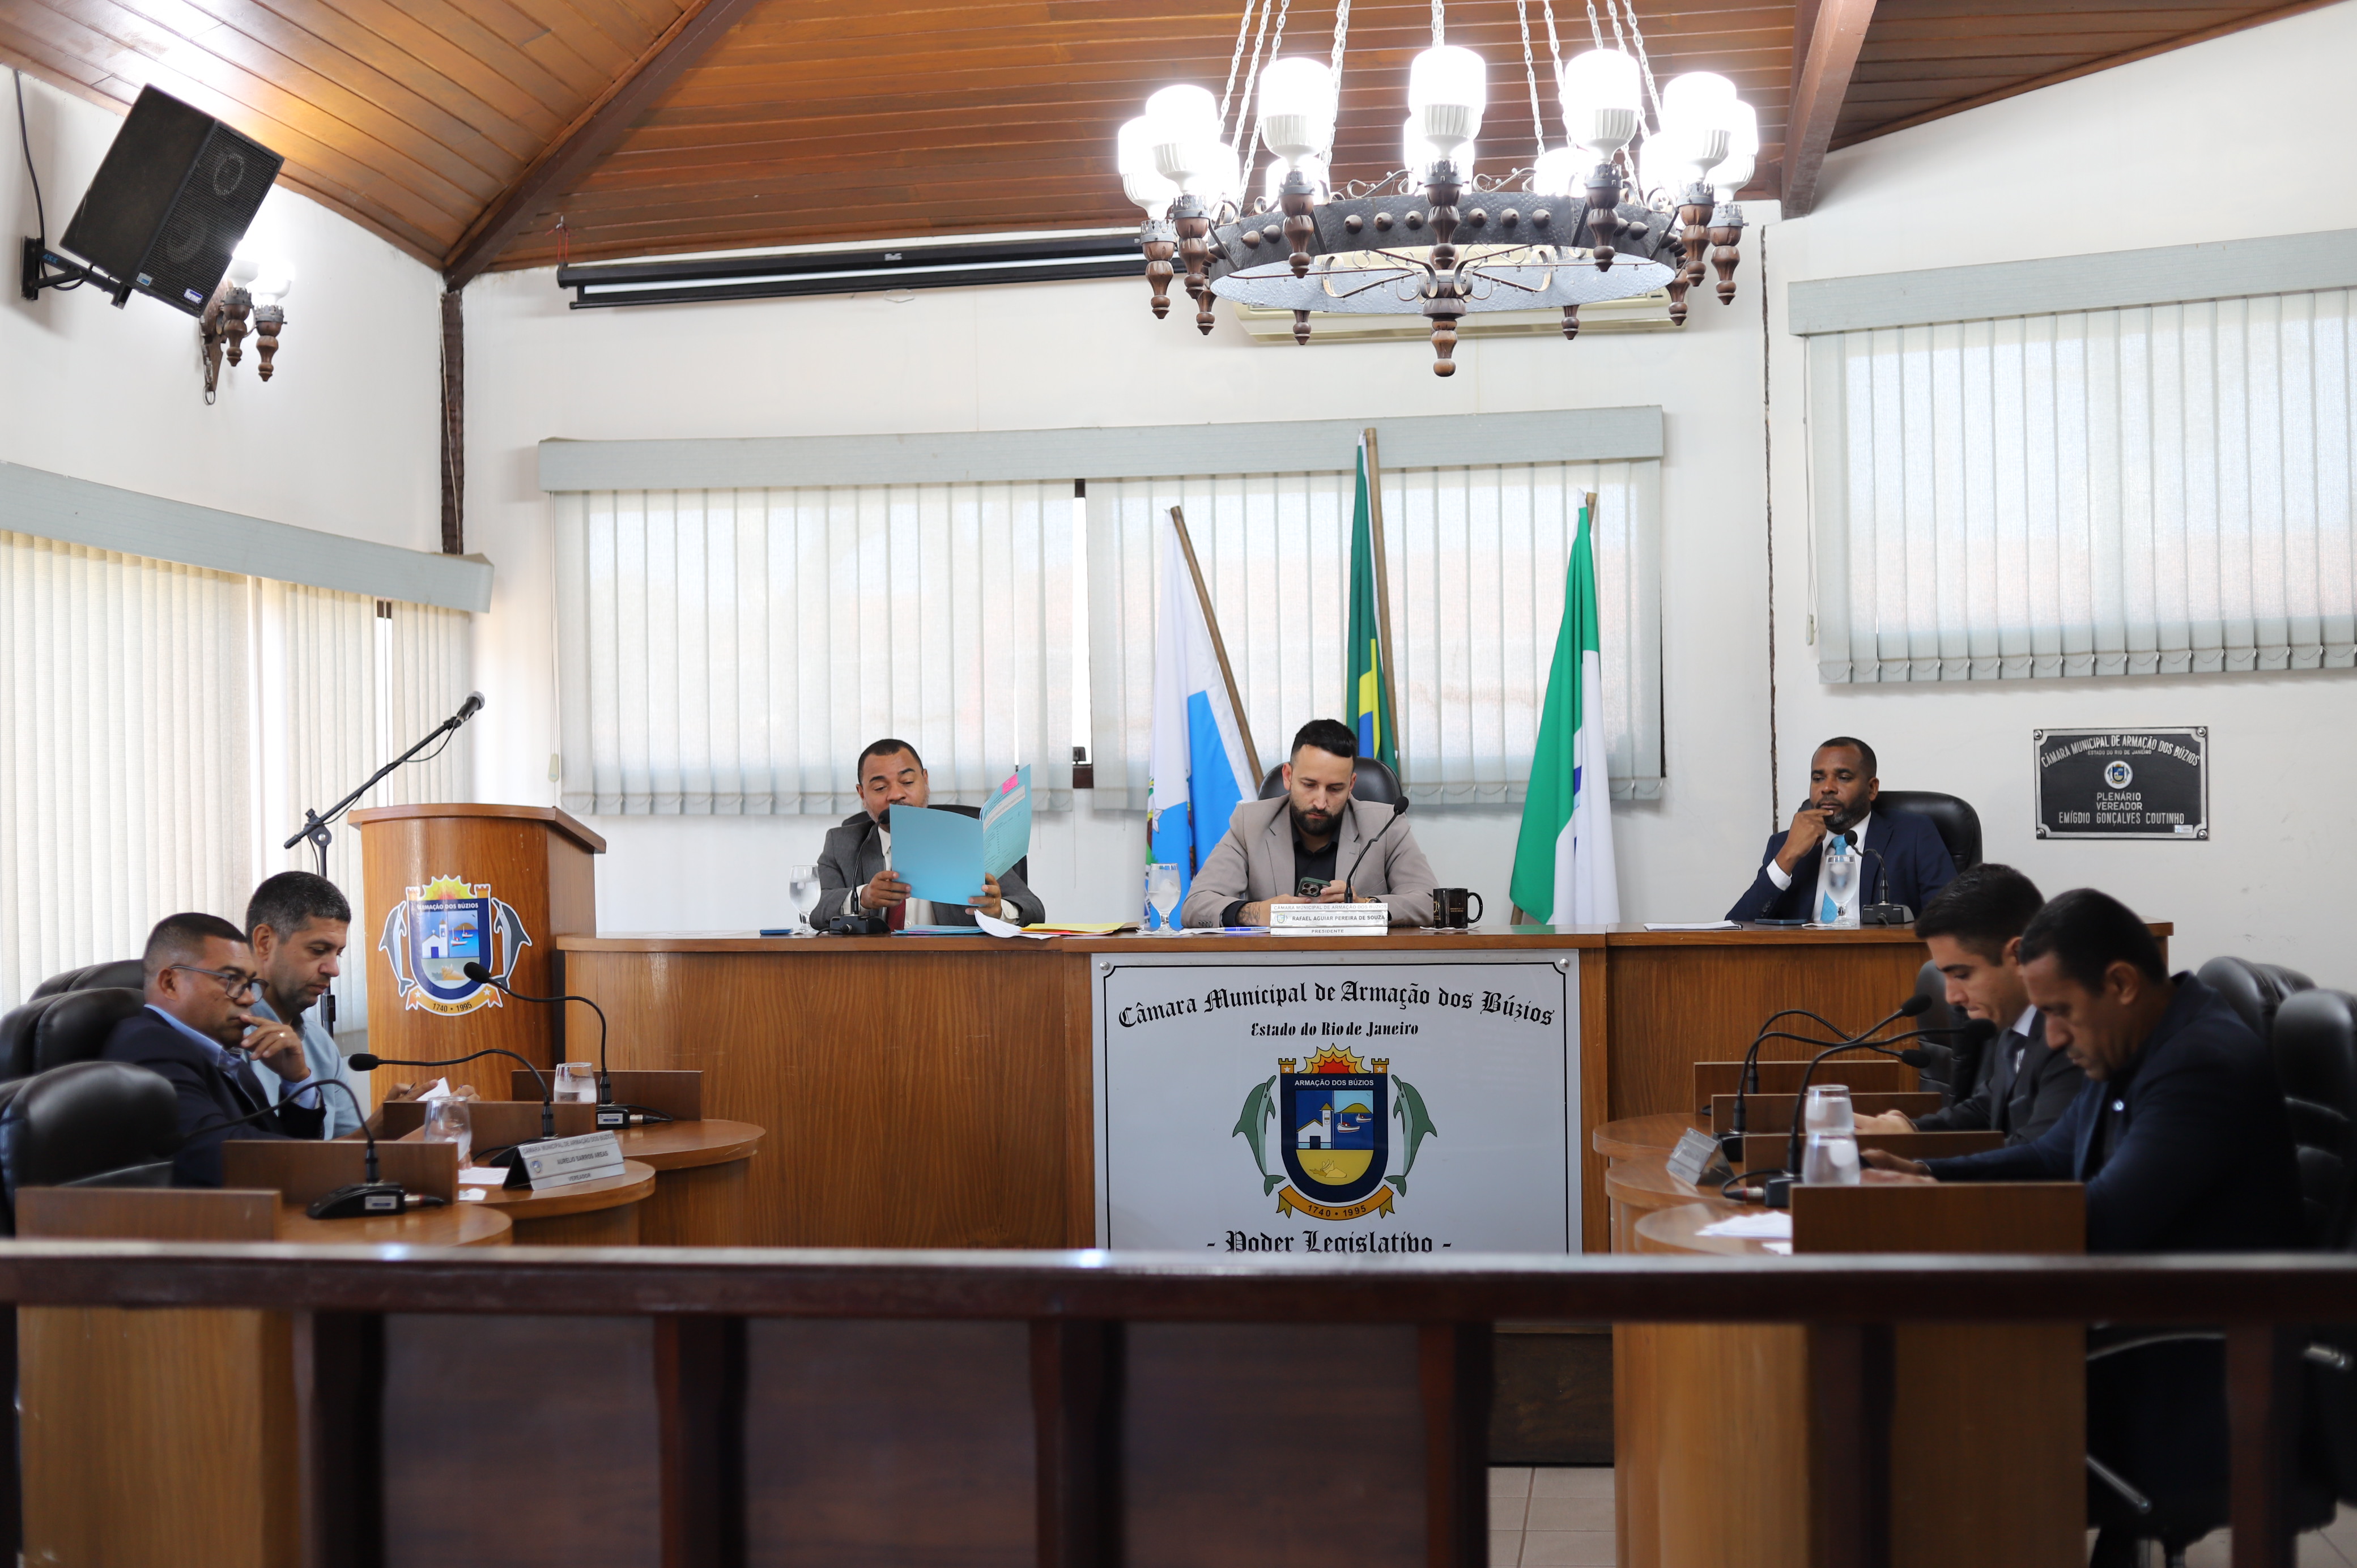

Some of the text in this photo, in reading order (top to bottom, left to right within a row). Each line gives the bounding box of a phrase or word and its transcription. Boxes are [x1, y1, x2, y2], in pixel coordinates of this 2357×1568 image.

[2071, 736, 2109, 755] MUNICIPAL
[2111, 735, 2120, 747] DE
[2122, 735, 2157, 750] ARMAÇÃO
[2158, 740, 2173, 755] DOS
[2173, 746, 2199, 766] BÚZIOS
[2097, 791, 2141, 801] PLENÁRIO
[2096, 802, 2142, 811] VEREADOR
[2059, 810, 2185, 826] EMÍGDIO GONÇALVES COUTINHO
[433, 1002, 472, 1012] 1740 1995
[1118, 981, 1555, 1028] Câmara Municipal de Armação dos Búzios
[1251, 1021, 1419, 1037] Estado do Rio de Janeiro
[1295, 1079, 1330, 1087] ARMAÇÃO
[542, 1141, 563, 1151] MUNICIPAL
[568, 1173, 591, 1182] VEREADOR
[1308, 1204, 1366, 1217] 1740 1995
[1225, 1230, 1294, 1253] Poder
[1303, 1230, 1433, 1255] Legislativo
